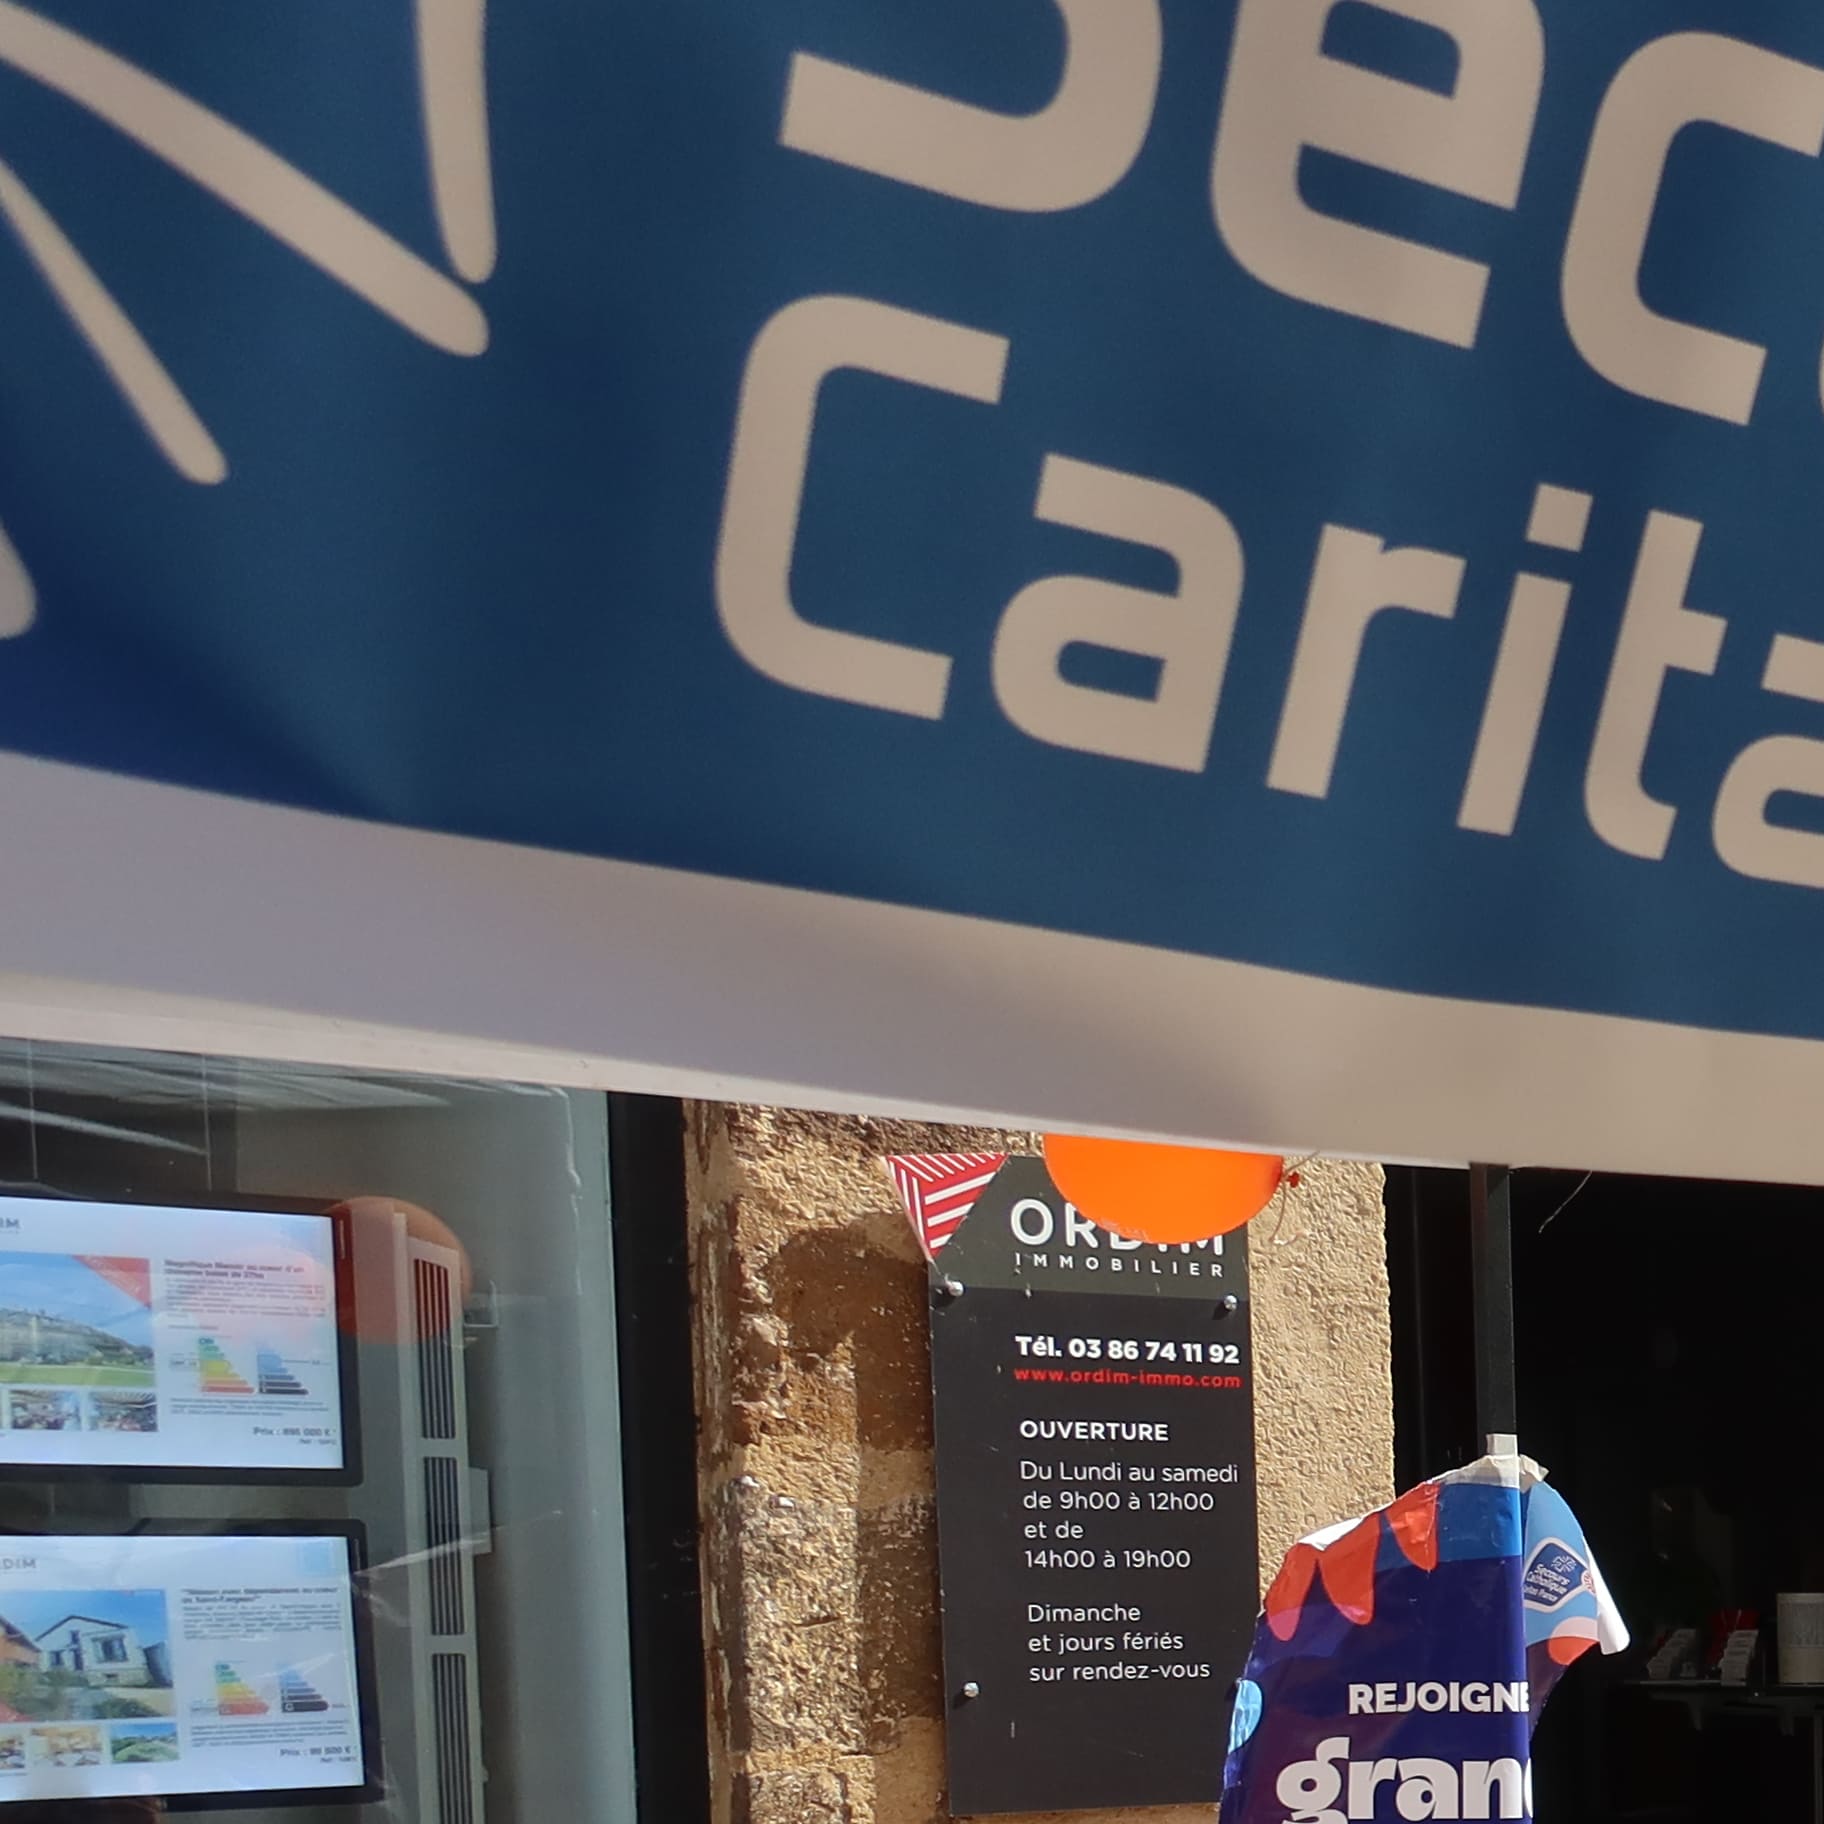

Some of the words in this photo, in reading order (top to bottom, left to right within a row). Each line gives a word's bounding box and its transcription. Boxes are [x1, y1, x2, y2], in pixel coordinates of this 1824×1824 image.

[1015, 1252, 1224, 1277] IMMOBILIER
[1015, 1335, 1062, 1357] Tél.
[1069, 1338, 1101, 1359] 03
[1107, 1339, 1138, 1360] 86
[1145, 1341, 1176, 1362] 74
[1182, 1342, 1202, 1363] 11
[1208, 1343, 1240, 1364] 92
[1014, 1368, 1241, 1389] www.ordim-immo.com
[1020, 1420, 1169, 1441] OUVERTURE
[1020, 1461, 1052, 1481] Du
[1060, 1461, 1122, 1482] Lundi
[1129, 1466, 1155, 1483] au
[1162, 1463, 1238, 1484] samedi
[1023, 1491, 1051, 1510] de
[1060, 1492, 1120, 1510] 9h00
[1128, 1491, 1140, 1510] à
[1149, 1492, 1214, 1511] 12h00
[1024, 1523, 1046, 1539] et
[1055, 1520, 1084, 1539] de
[1025, 1550, 1095, 1568] 14h00
[1103, 1549, 1115, 1568] à
[1124, 1550, 1191, 1568] 19h00
[1028, 1603, 1141, 1622] Dimanche
[1029, 1635, 1051, 1652] et
[1057, 1634, 1114, 1655] jours
[1123, 1632, 1183, 1650] fériés
[1029, 1666, 1063, 1682] sur
[1072, 1661, 1210, 1680] rendez-vous
